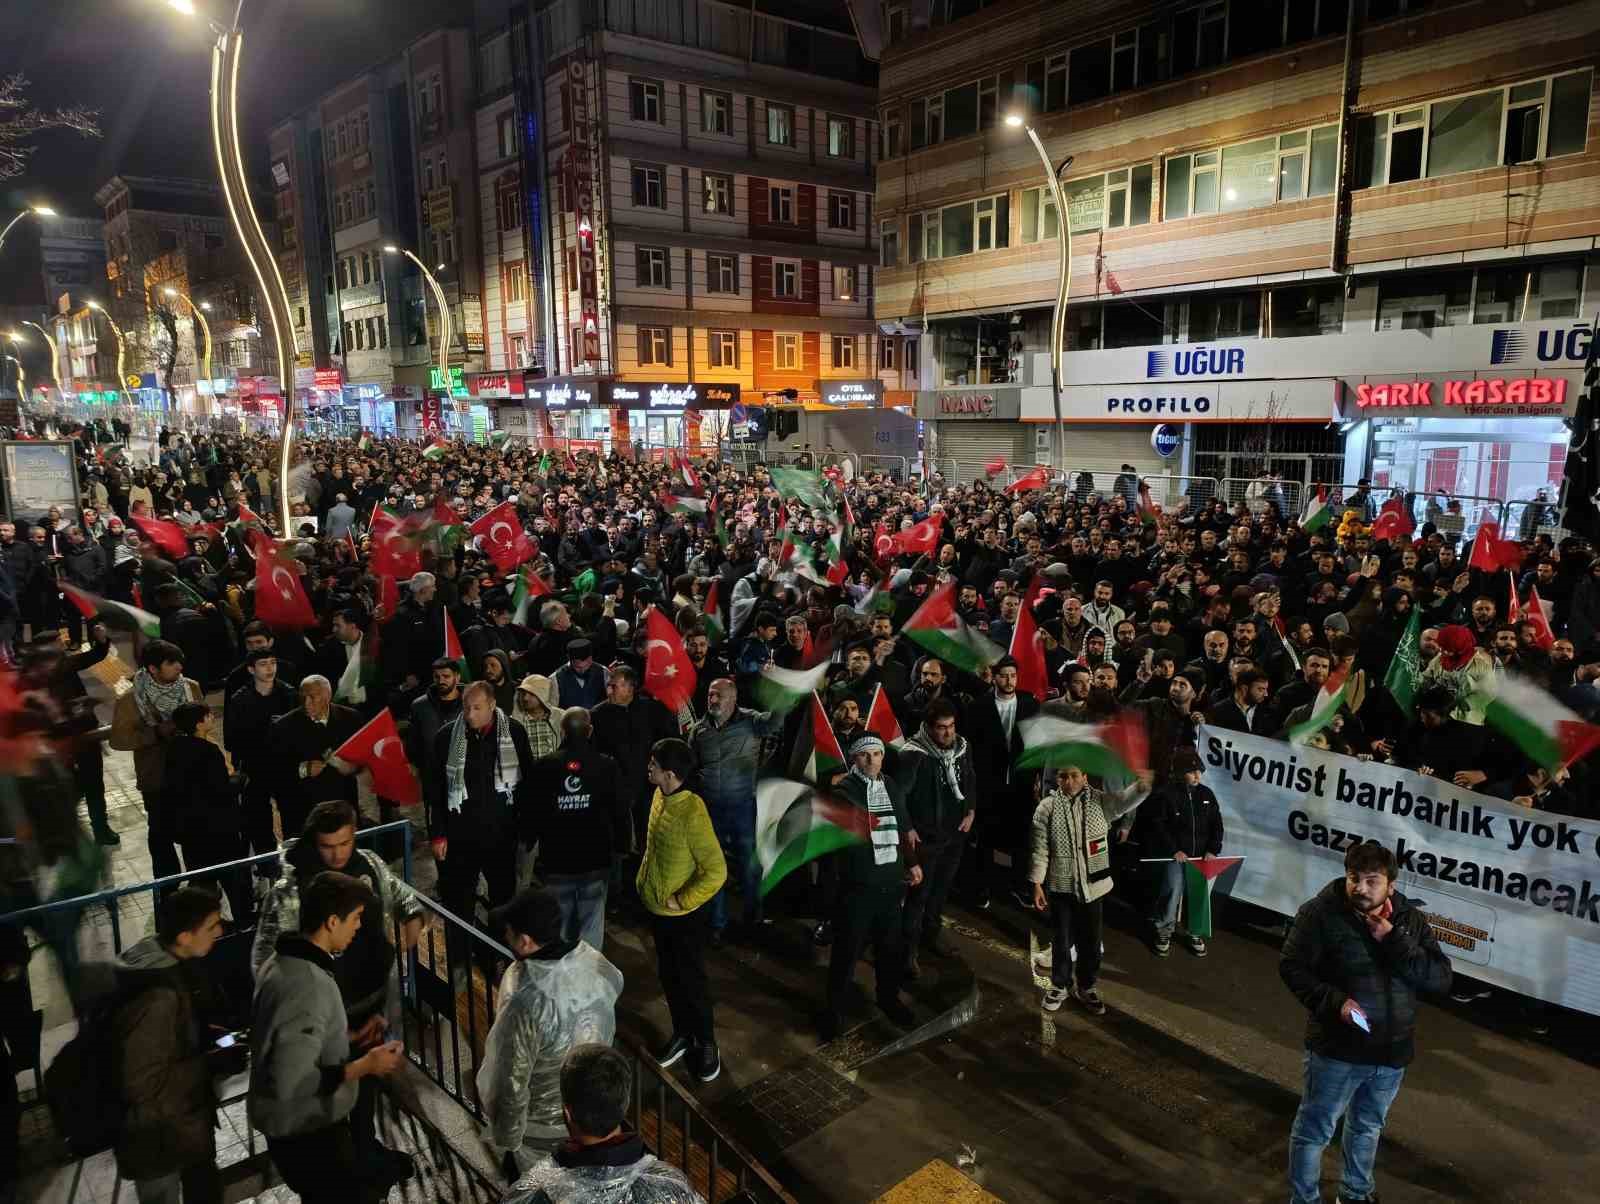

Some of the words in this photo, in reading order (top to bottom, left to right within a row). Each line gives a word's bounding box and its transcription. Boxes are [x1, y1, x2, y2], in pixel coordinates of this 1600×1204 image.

[571, 61, 586, 143] OTEL
[1174, 347, 1244, 375] UĞUR
[1537, 323, 1600, 361] UĞ
[840, 384, 864, 393] OTEL
[1207, 736, 1326, 797] Siyonist
[1336, 768, 1494, 838] barbarlık
[1508, 818, 1582, 854] yok
[1288, 810, 1383, 853] Gazz
[1396, 838, 1600, 923] kazanacak
